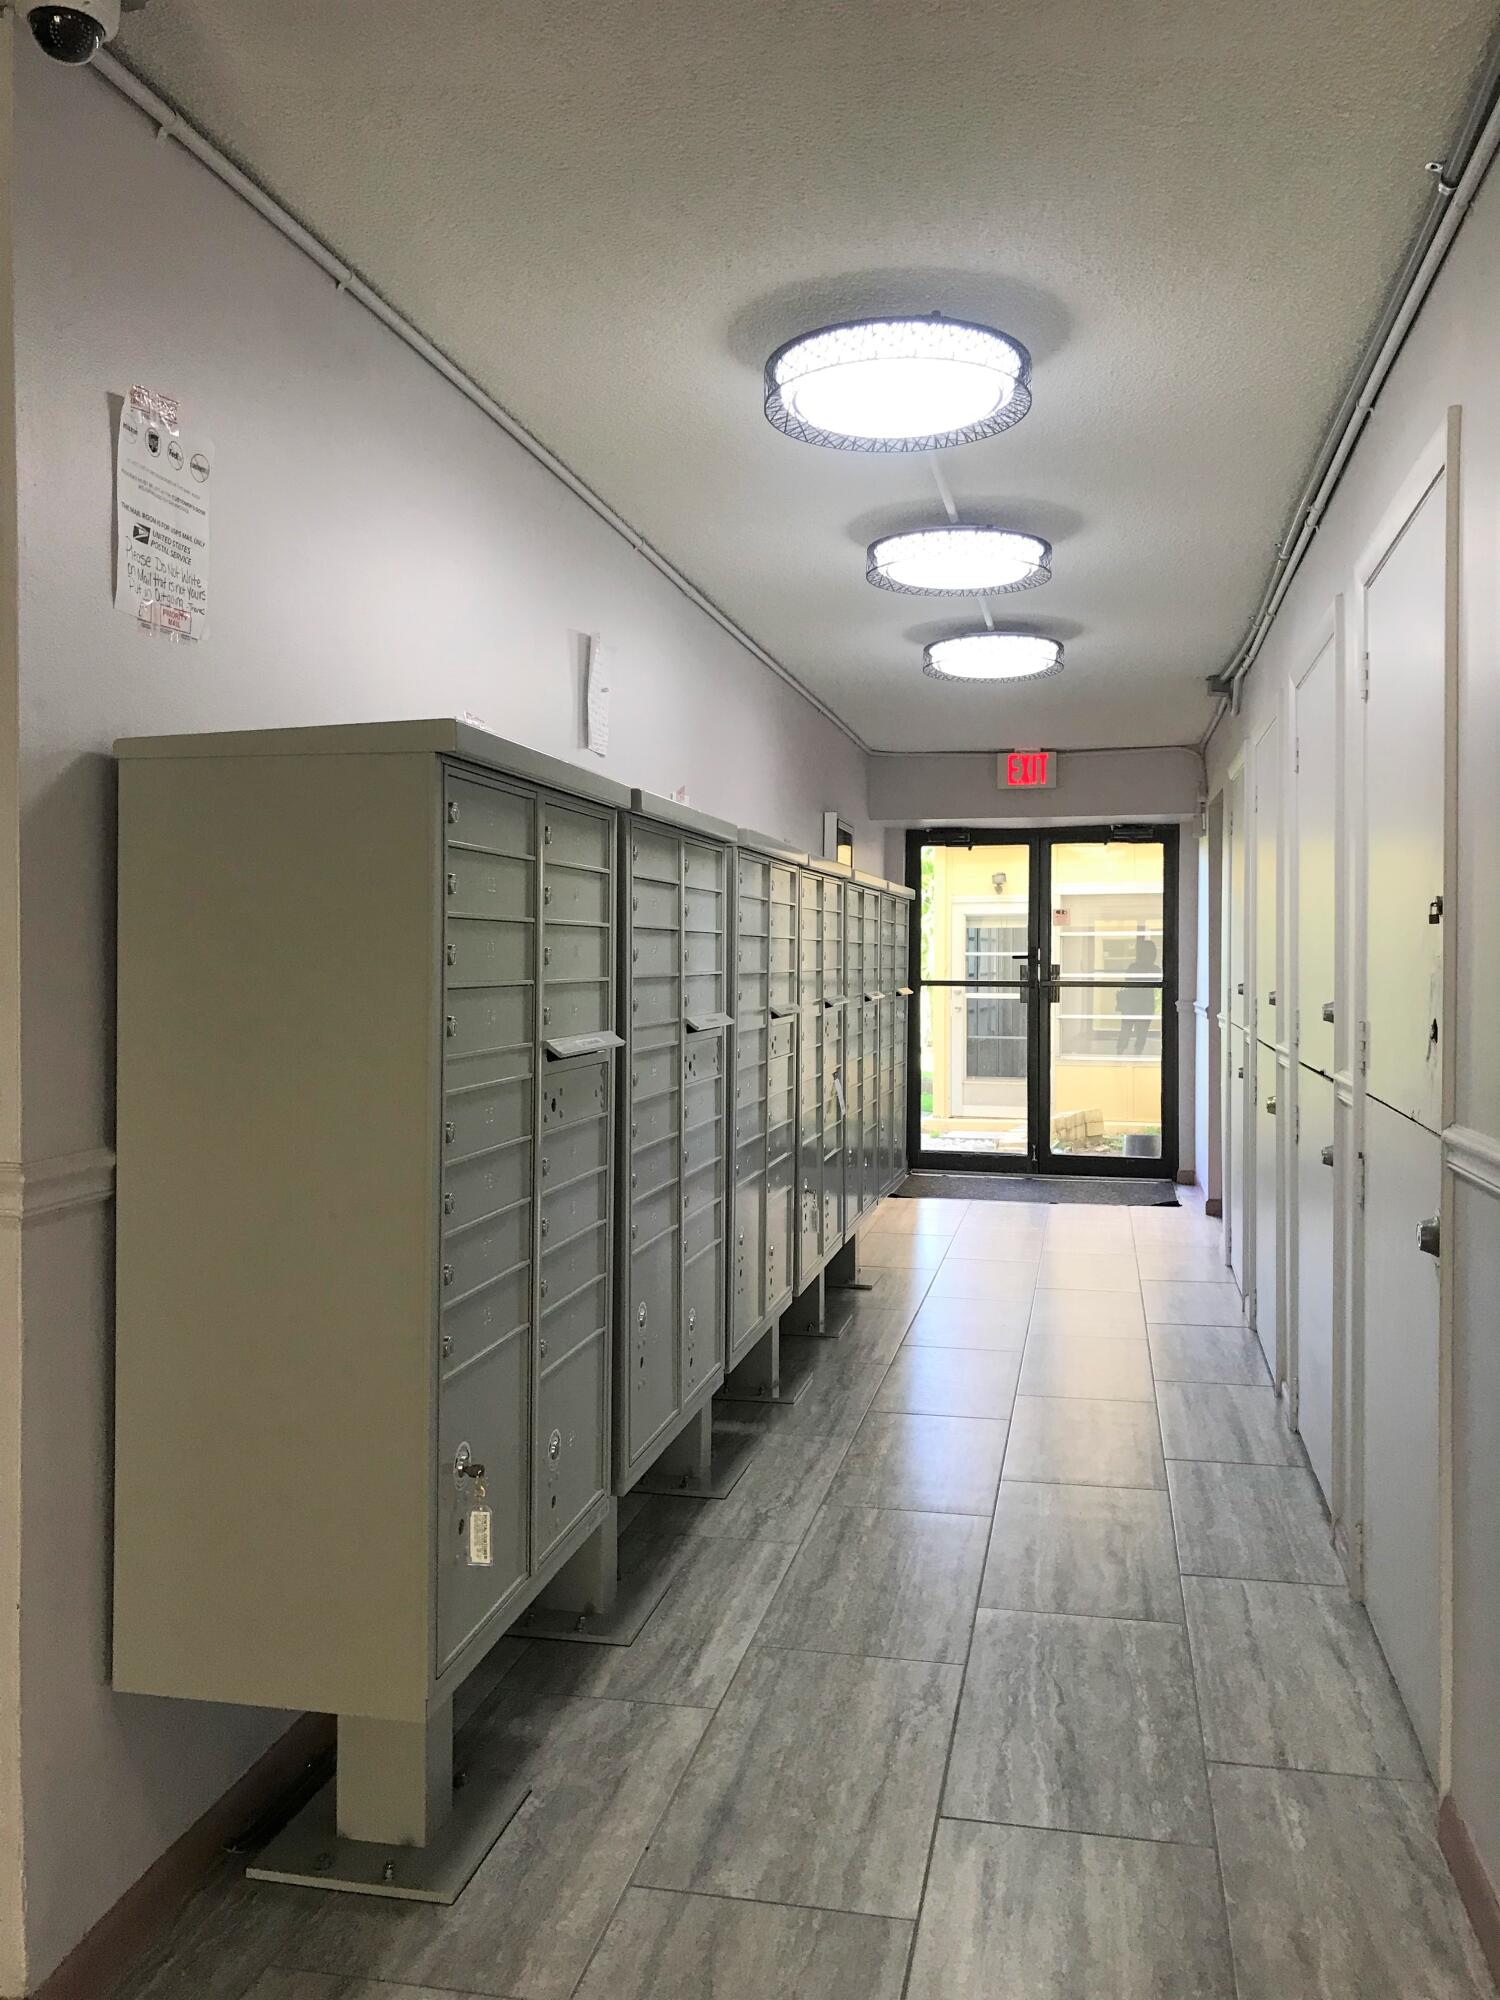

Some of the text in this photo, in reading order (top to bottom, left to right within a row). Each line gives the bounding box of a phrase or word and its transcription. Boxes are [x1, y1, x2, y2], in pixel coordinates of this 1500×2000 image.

[130, 506, 141, 518] MAIL
[142, 512, 157, 523] ROOM
[161, 521, 170, 531] FOR
[171, 527, 182, 537] USPS
[182, 532, 193, 542] MAIL
[194, 539, 206, 549] ONLY
[150, 539, 192, 566] POSTAL SERVICE
[152, 530, 191, 555] UNITED STATES
[125, 538, 152, 568] Please
[154, 556, 167, 574] Do
[137, 567, 152, 587] Mail
[162, 608, 188, 621] PRIORITY
[168, 618, 181, 629] MAIL
[1007, 753, 1048, 786] EXIT
